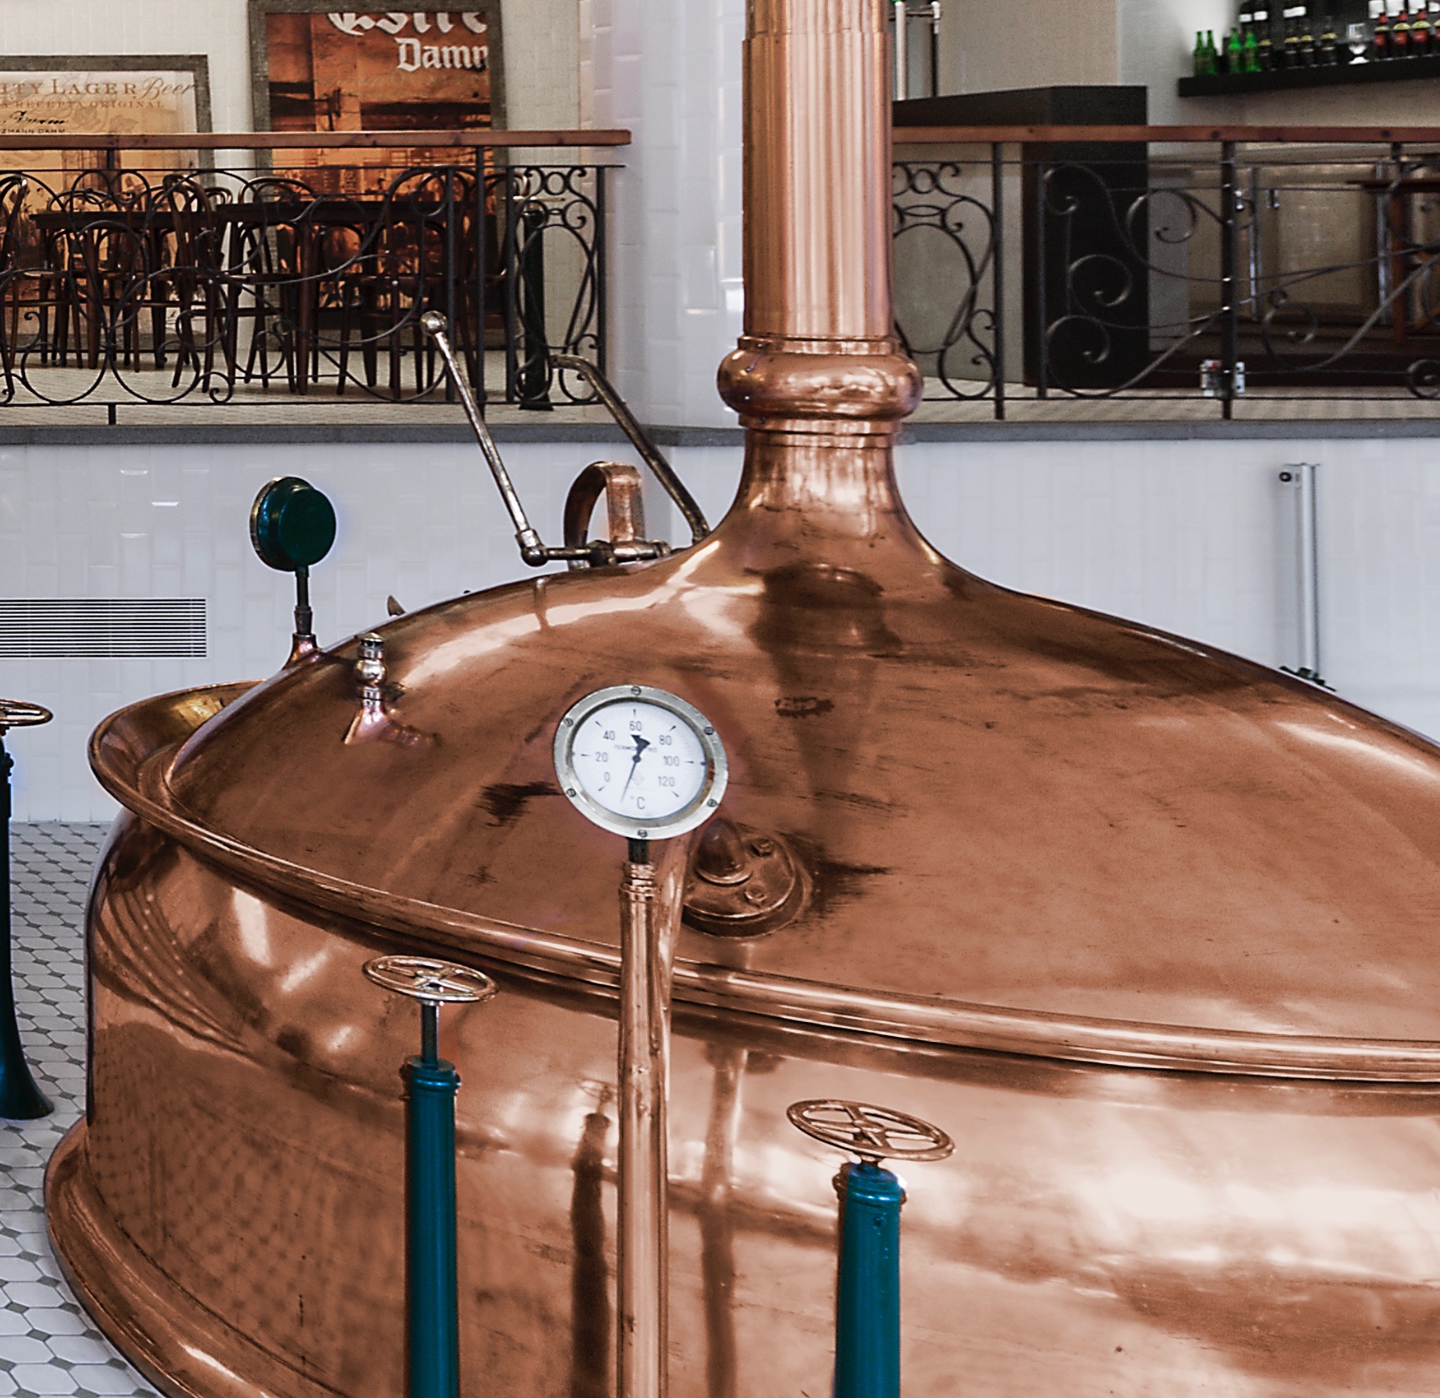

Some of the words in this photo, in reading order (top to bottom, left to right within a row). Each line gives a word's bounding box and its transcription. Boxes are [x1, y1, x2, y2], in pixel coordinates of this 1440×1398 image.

[52, 79, 137, 95] LAGER
[138, 77, 197, 100] Beer
[629, 721, 642, 732] 60
[603, 730, 616, 741] 40
[659, 735, 672, 745] 80
[595, 752, 608, 762] 20
[663, 756, 680, 767] 100
[604, 772, 610, 782] 0
[658, 776, 676, 787] 120
